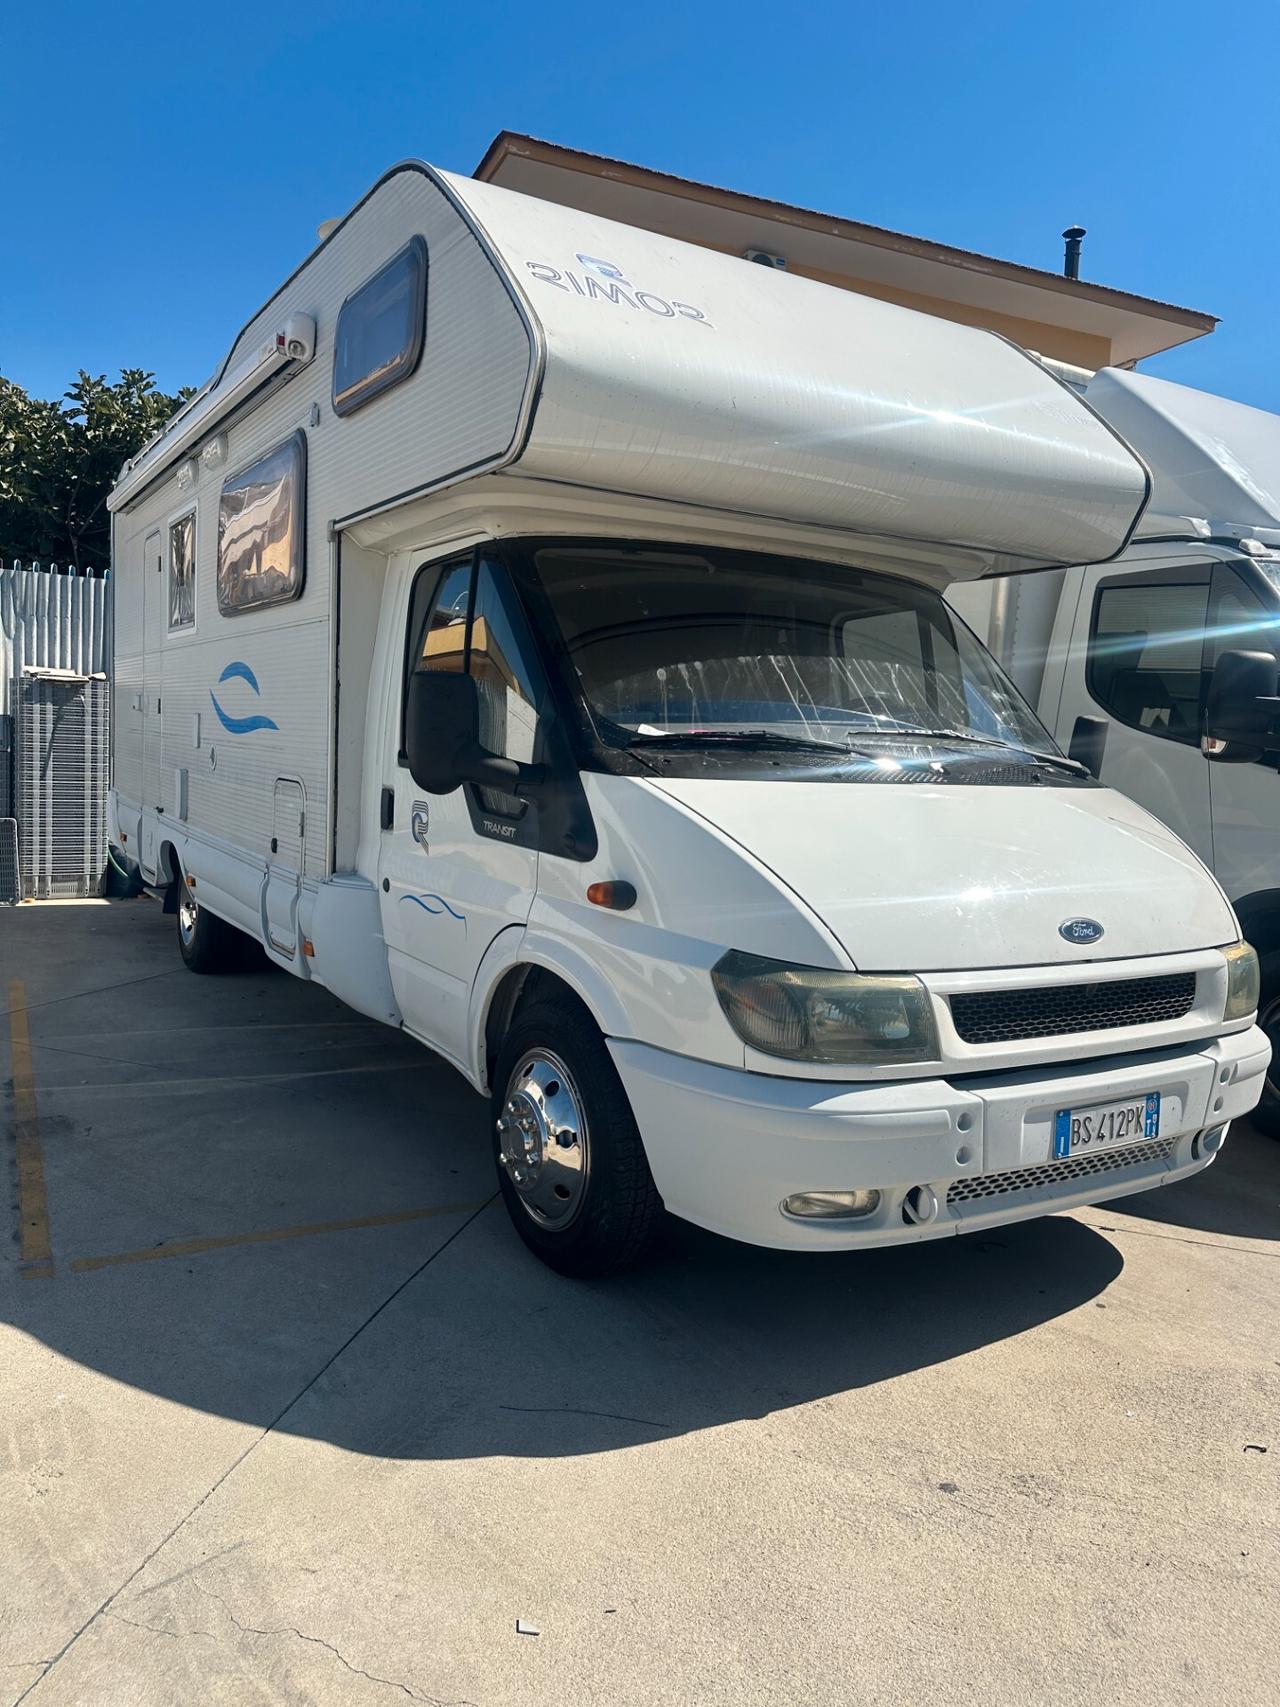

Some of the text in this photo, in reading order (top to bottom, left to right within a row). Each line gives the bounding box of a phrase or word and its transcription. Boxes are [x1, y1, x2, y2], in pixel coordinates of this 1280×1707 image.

[526, 261, 715, 328] RIMOR
[483, 820, 516, 838] TRANSIT
[1072, 923, 1095, 936] Ford
